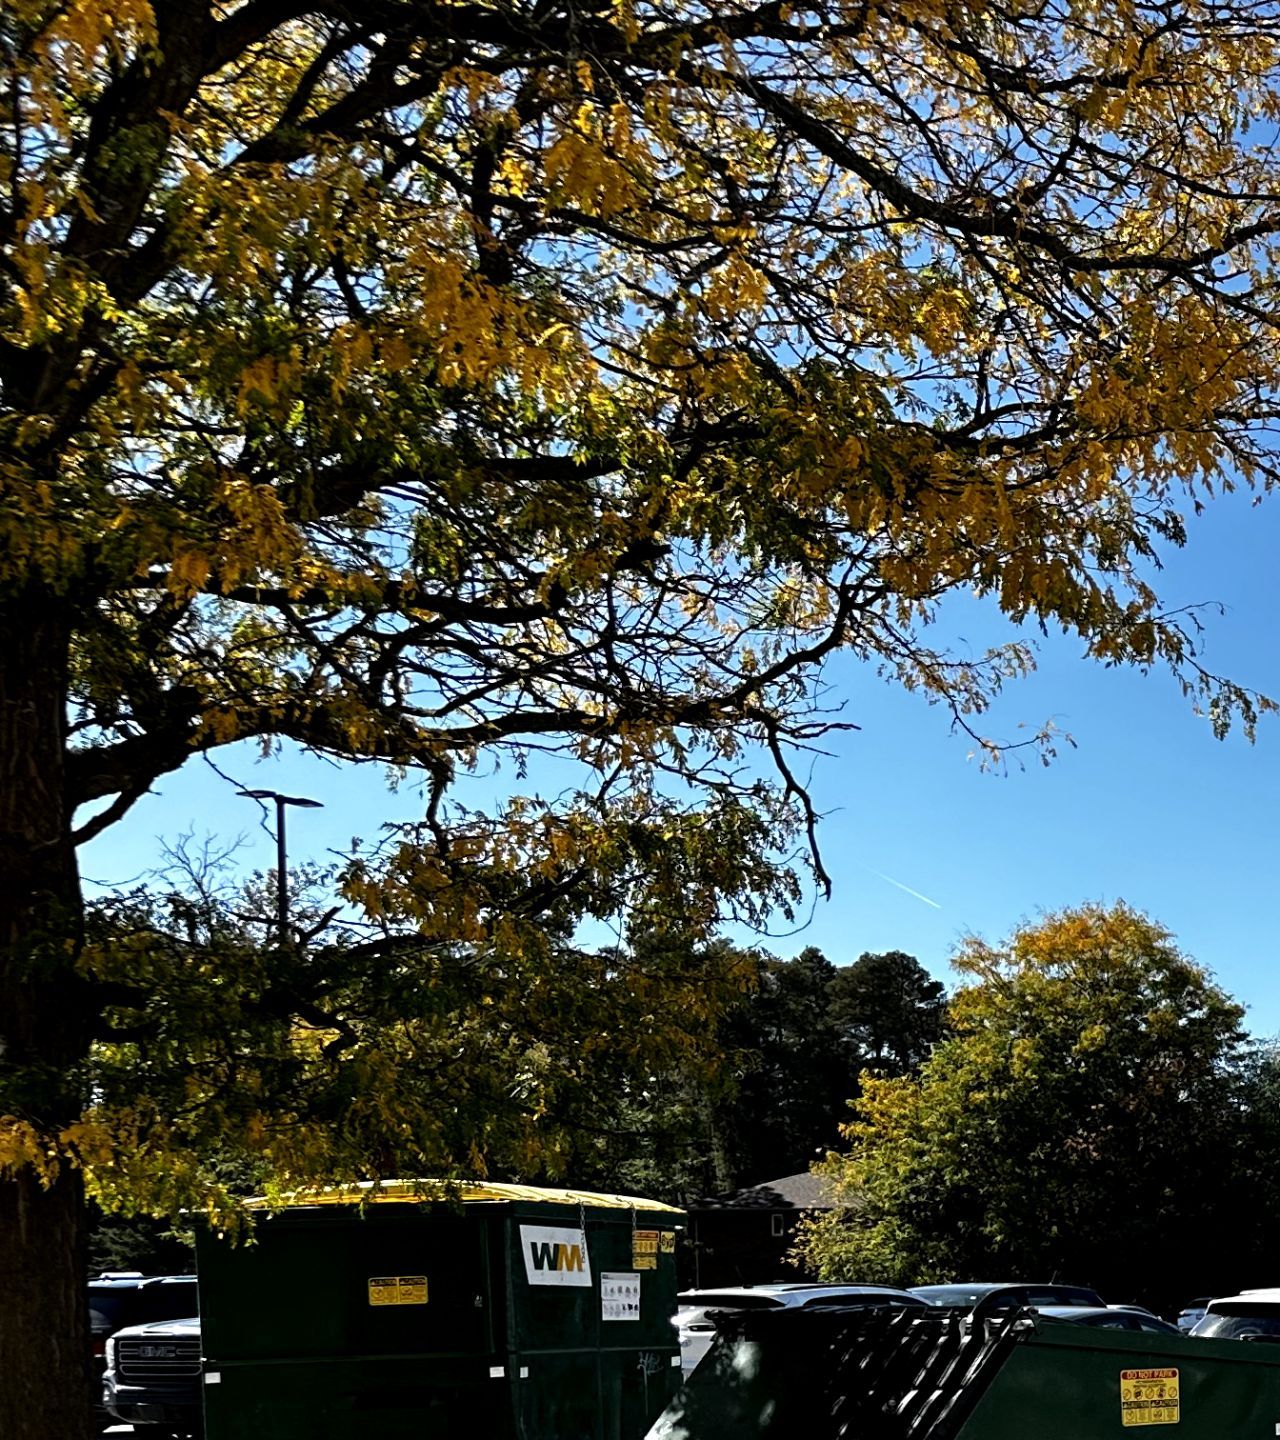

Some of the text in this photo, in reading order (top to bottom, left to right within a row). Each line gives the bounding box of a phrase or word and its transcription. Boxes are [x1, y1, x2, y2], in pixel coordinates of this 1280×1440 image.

[530, 1241, 585, 1272] WM
[140, 1346, 176, 1357] GMC
[1126, 1371, 1138, 1379] DO
[1139, 1370, 1153, 1379] NOT
